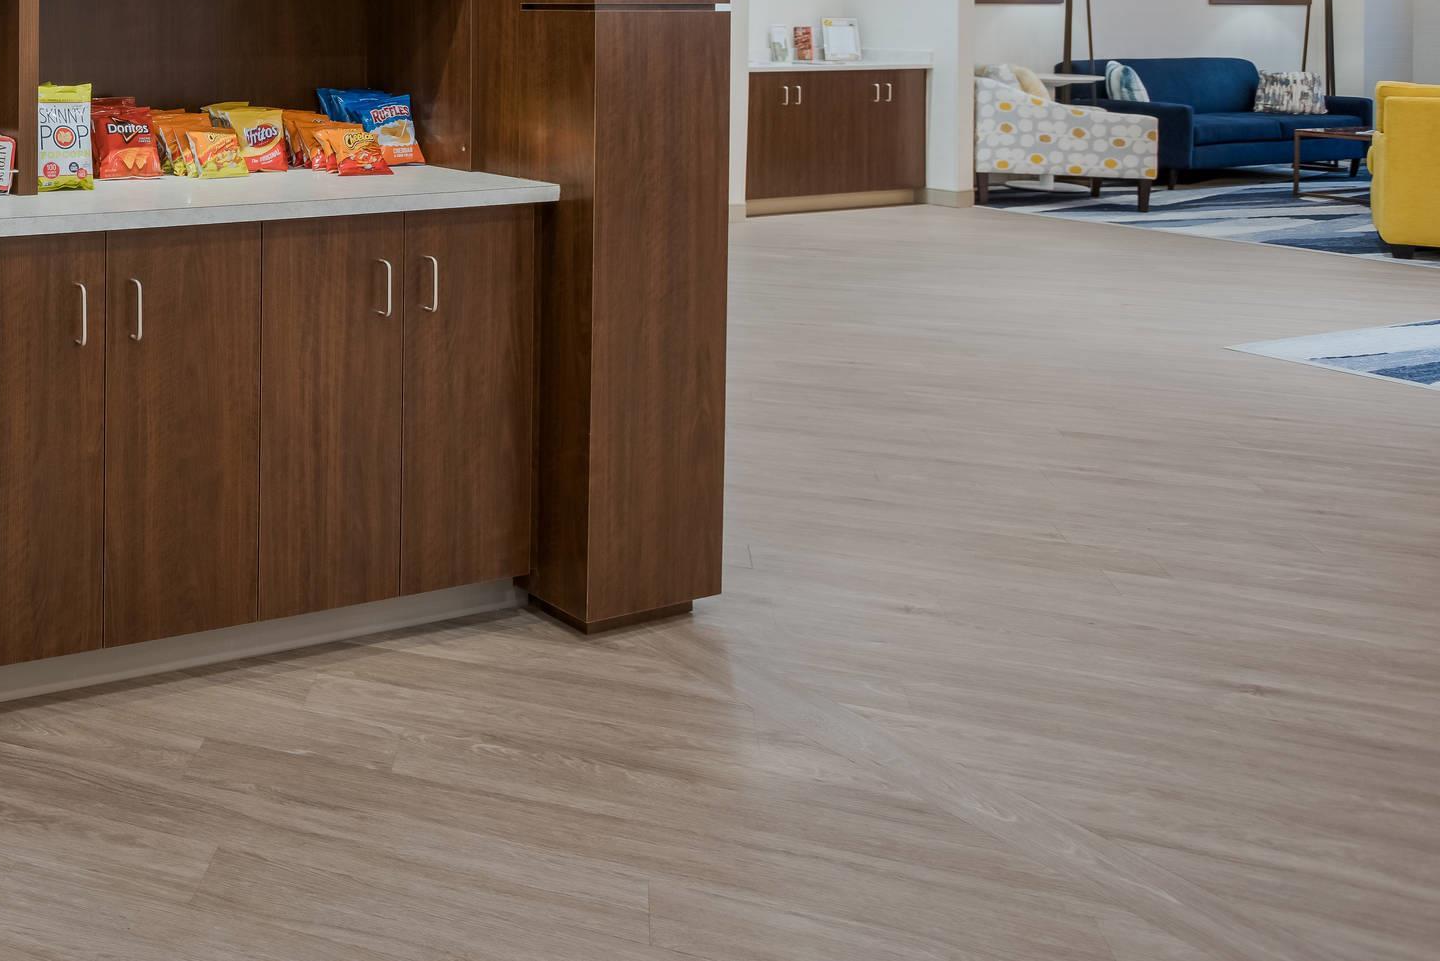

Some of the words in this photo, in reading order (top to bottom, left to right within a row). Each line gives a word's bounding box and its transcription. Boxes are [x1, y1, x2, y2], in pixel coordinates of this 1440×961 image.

[369, 105, 410, 124] RUFFLES
[40, 124, 89, 151] POP
[107, 123, 149, 134] Doritos
[245, 126, 278, 148] Fritos
[344, 132, 374, 149] Cheetos
